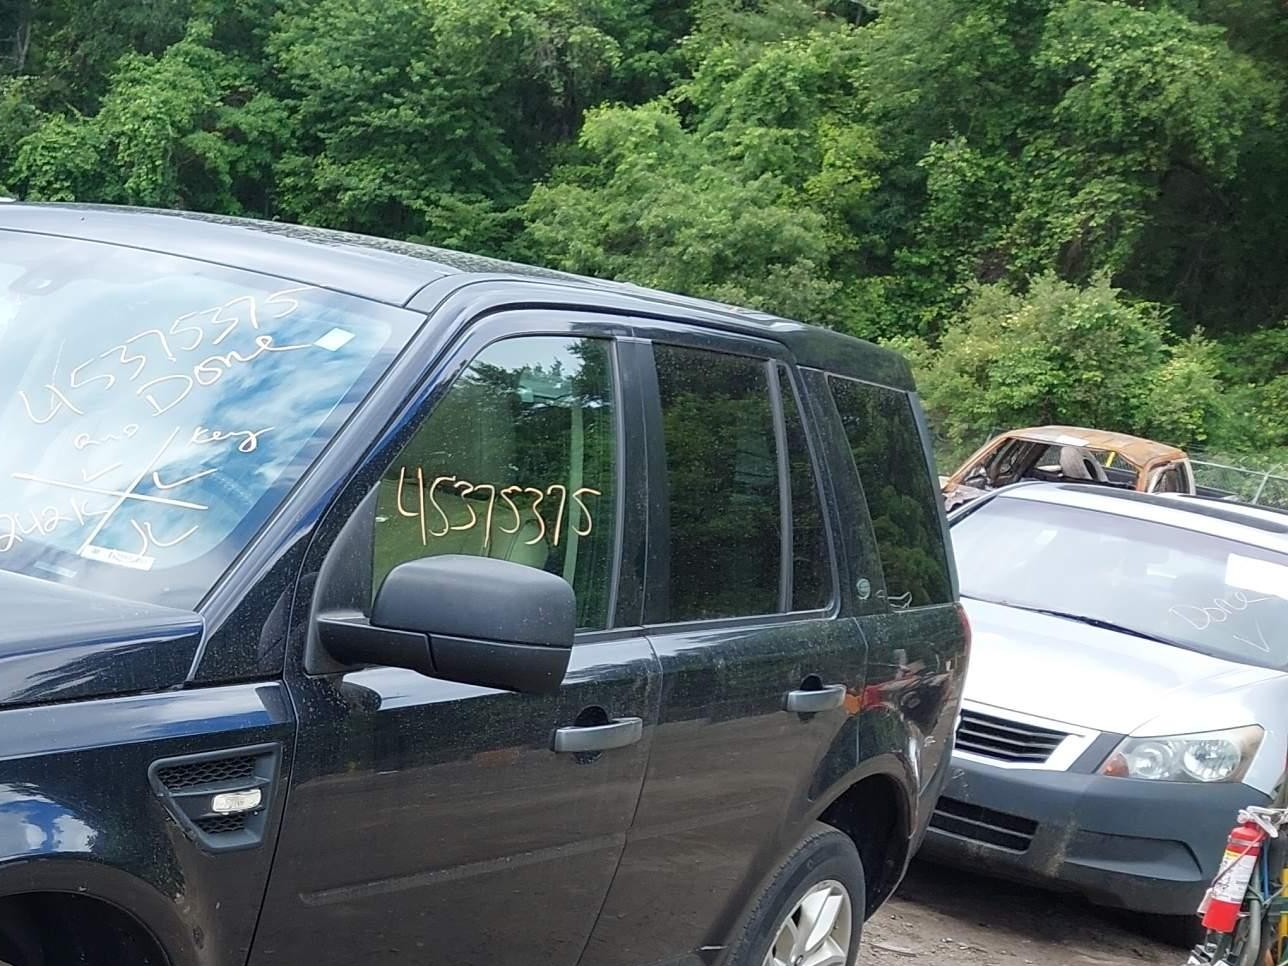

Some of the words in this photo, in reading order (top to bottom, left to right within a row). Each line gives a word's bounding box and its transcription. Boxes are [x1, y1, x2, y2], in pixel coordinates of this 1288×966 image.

[19, 287, 316, 424] 45375375
[137, 335, 312, 416] Done
[397, 467, 602, 547] 45375375
